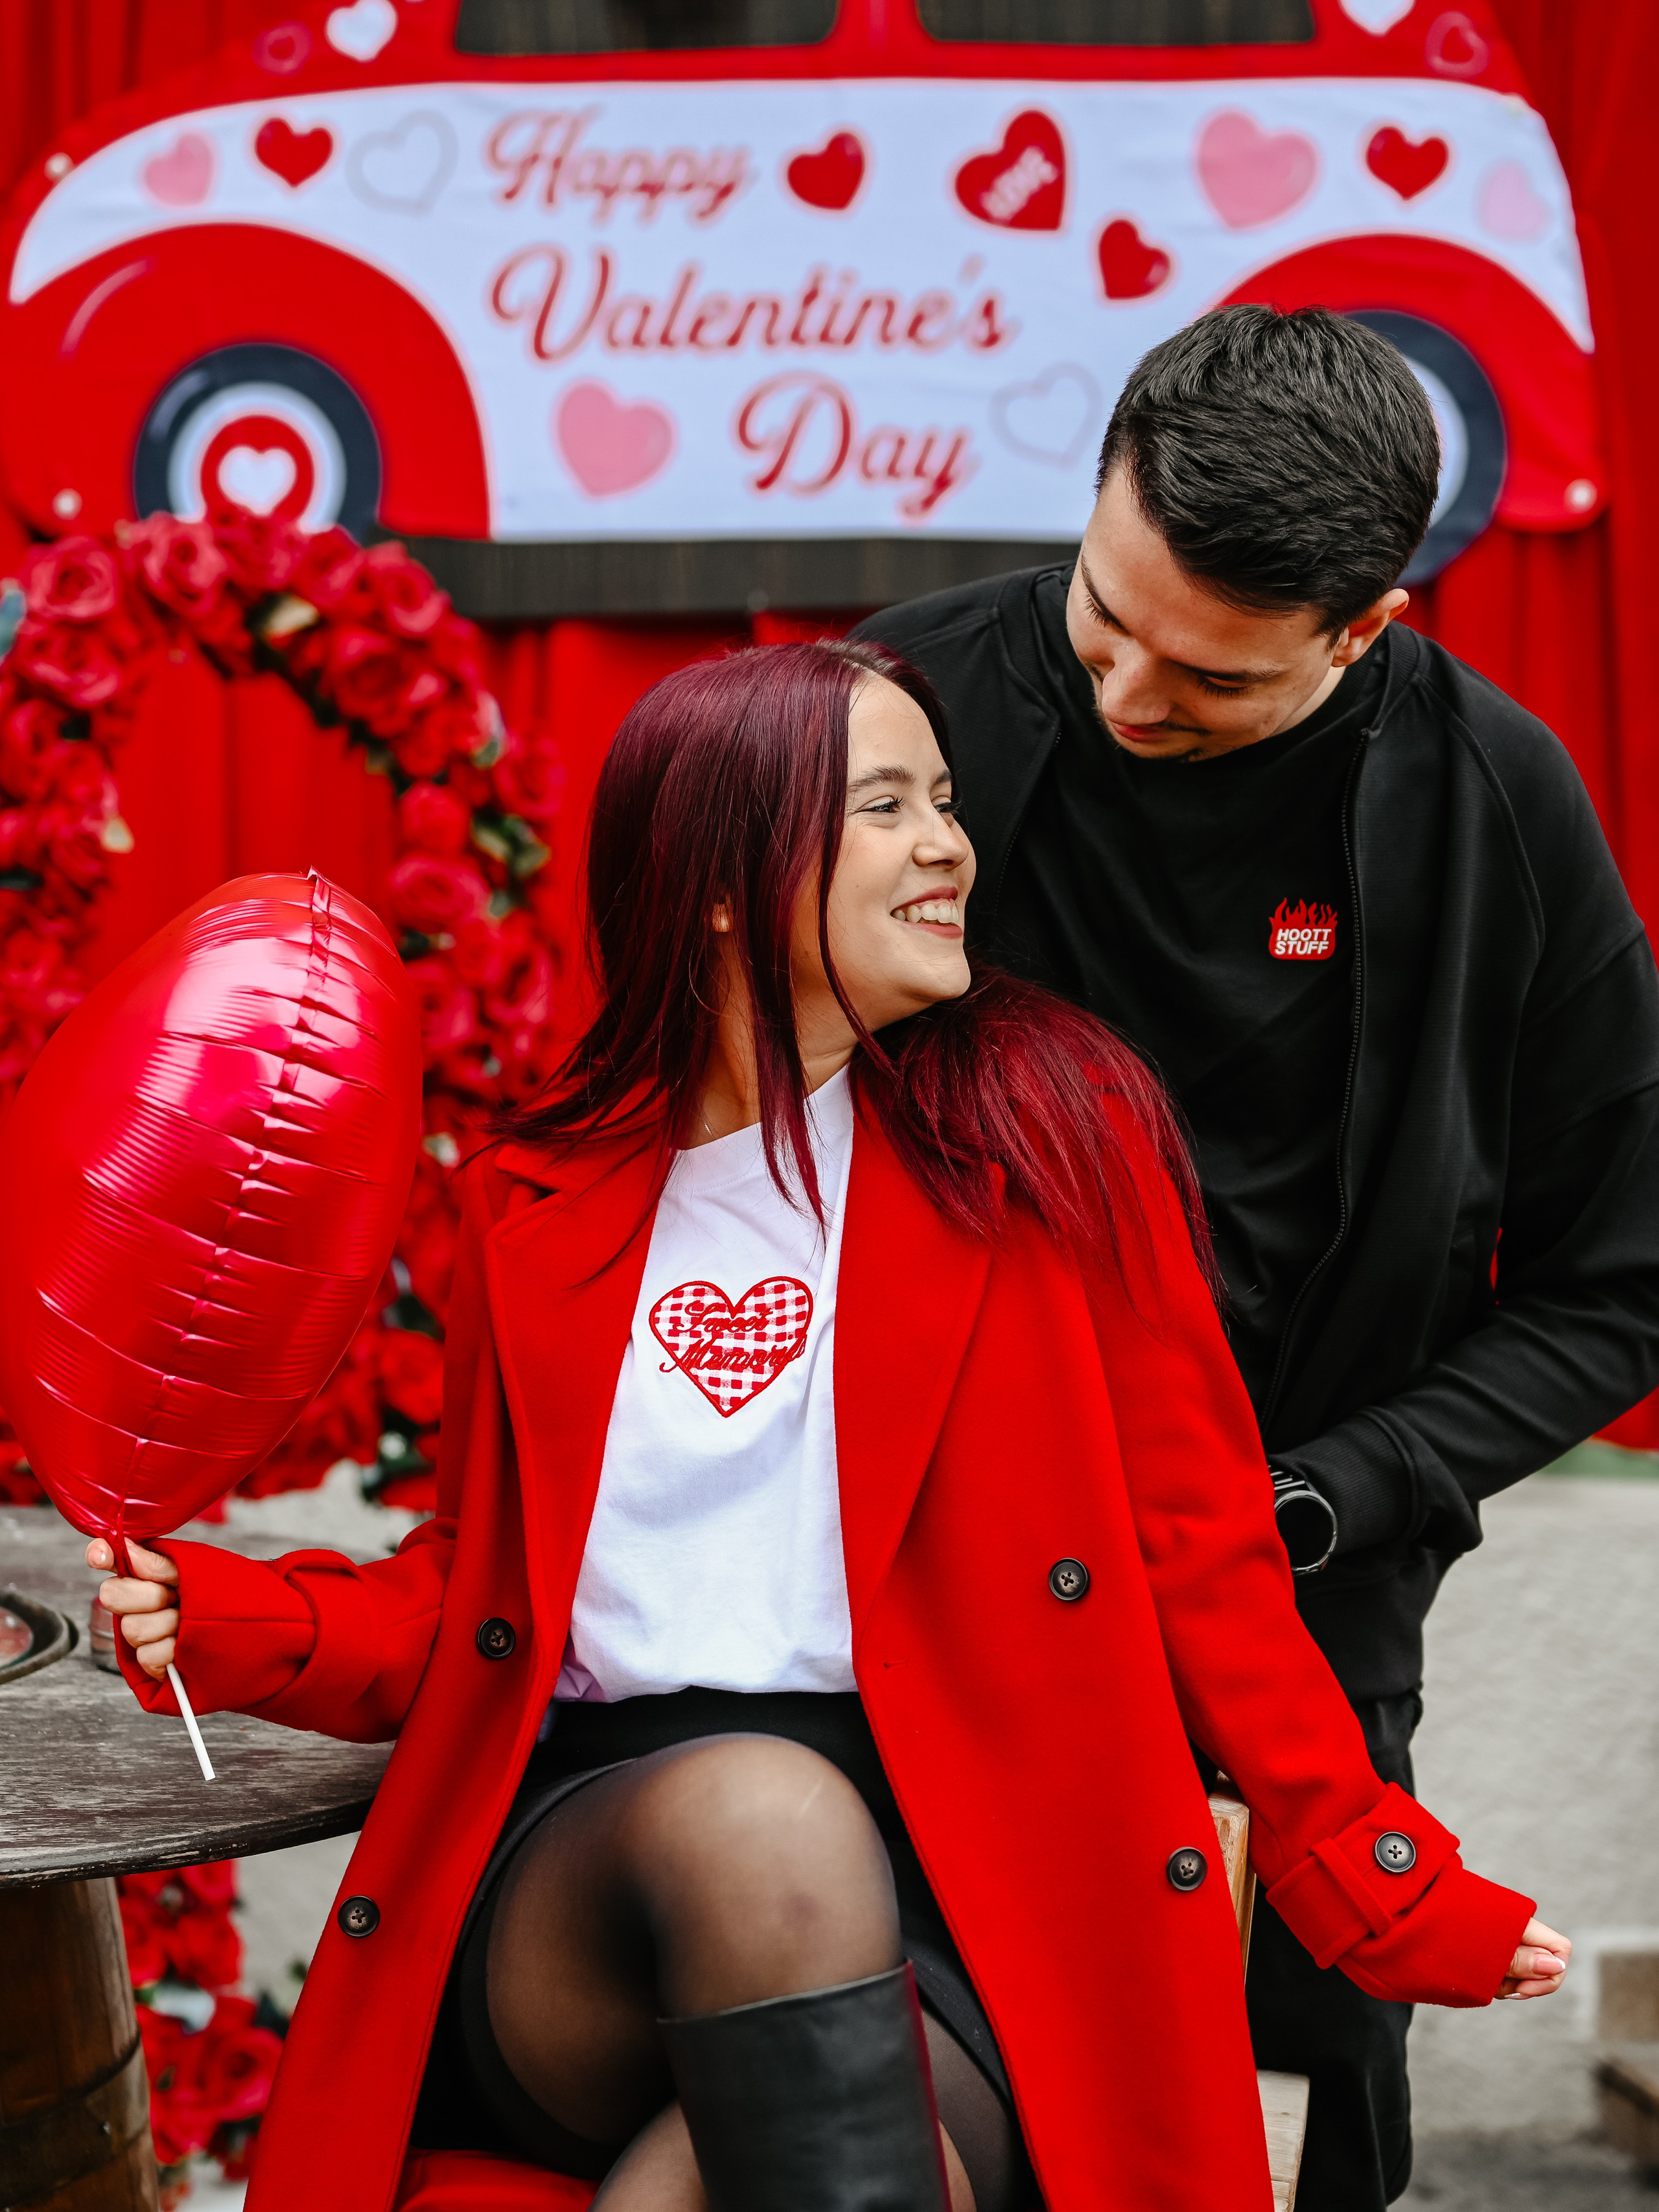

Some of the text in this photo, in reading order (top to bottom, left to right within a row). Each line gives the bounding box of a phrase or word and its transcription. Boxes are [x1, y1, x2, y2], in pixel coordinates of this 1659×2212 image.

[486, 106, 749, 222] Happy
[490, 244, 1015, 358] Valentine's
[736, 372, 975, 520] Day
[1275, 941, 1329, 955] STUFF
[1277, 928, 1332, 941] HOOTT
[673, 1299, 774, 1333] Sweet
